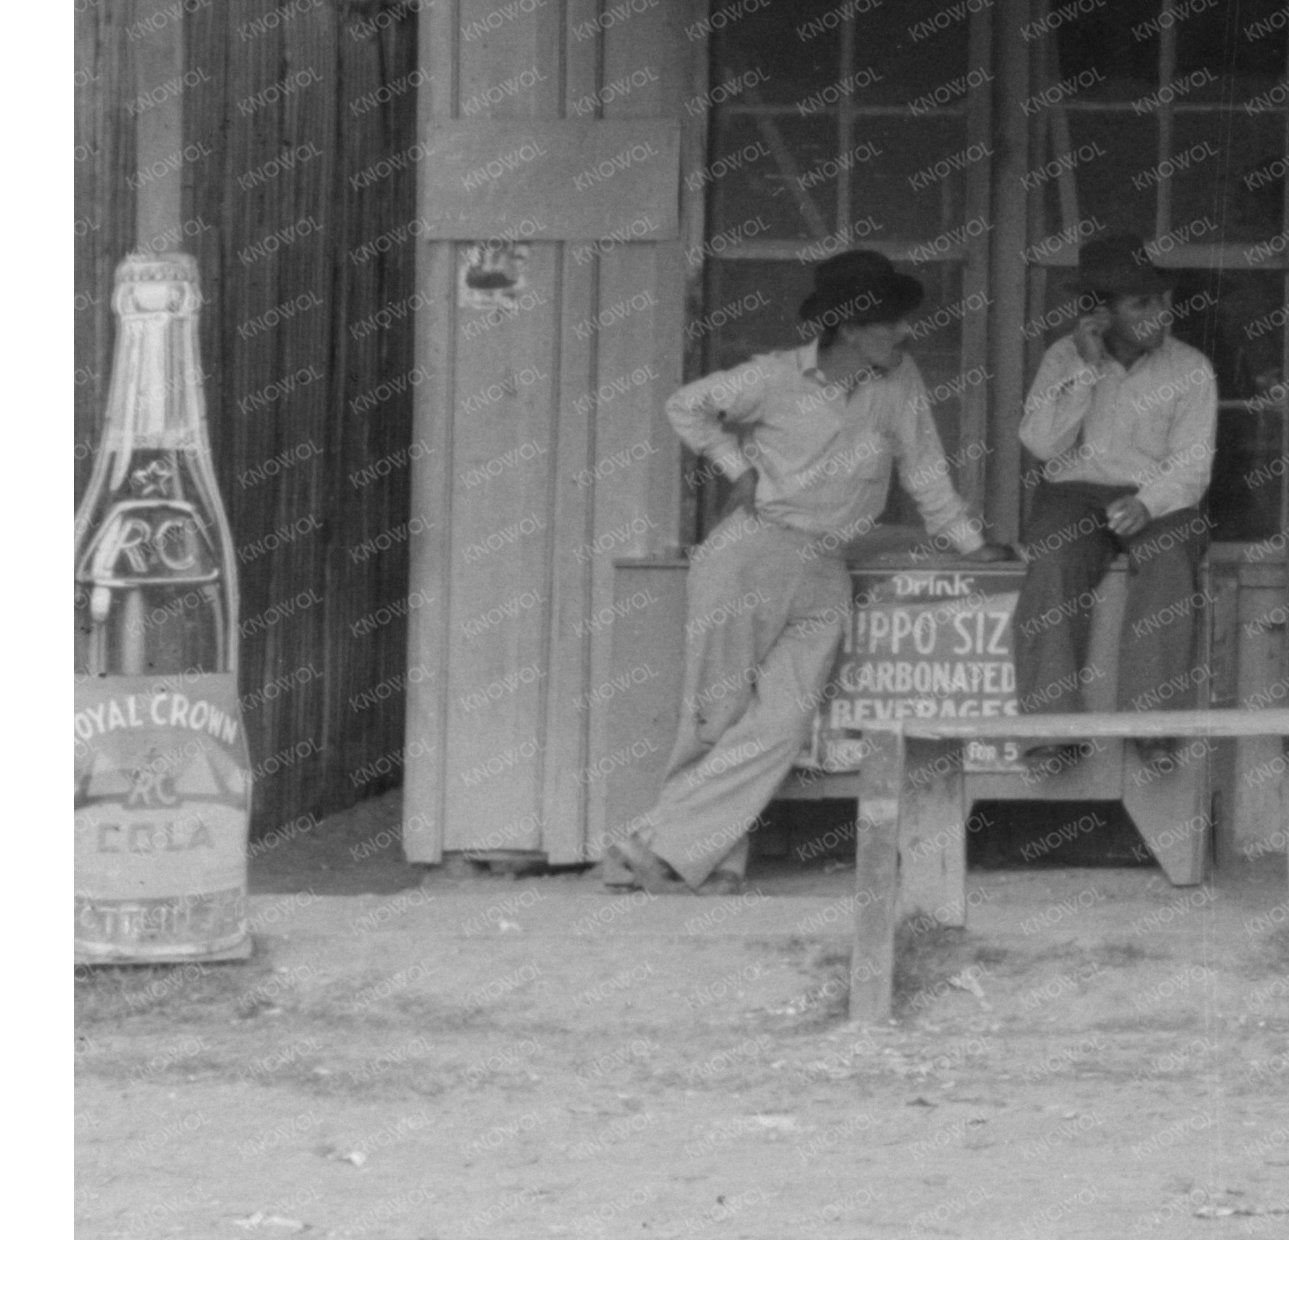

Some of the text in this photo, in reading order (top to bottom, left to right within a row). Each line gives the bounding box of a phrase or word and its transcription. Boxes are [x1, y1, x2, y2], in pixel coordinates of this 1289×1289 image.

[117, 517, 196, 572] RC
[892, 573, 975, 596] Drink
[840, 661, 1017, 693] CARBONATED
[74, 693, 239, 745] OYAL CROWN
